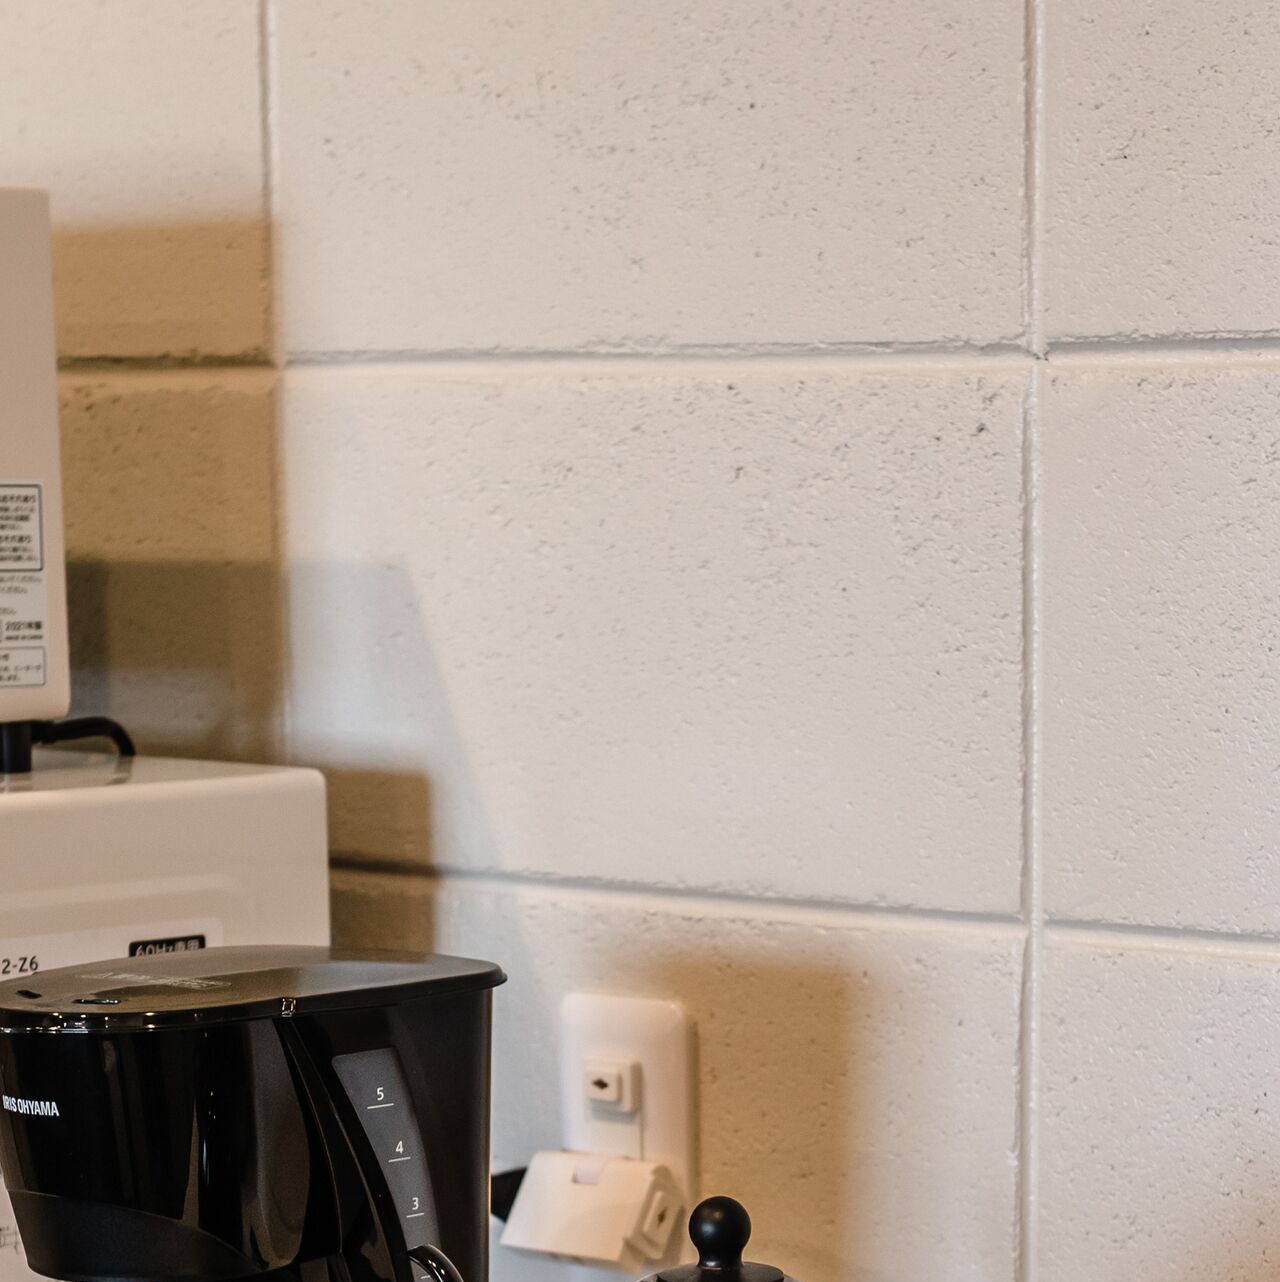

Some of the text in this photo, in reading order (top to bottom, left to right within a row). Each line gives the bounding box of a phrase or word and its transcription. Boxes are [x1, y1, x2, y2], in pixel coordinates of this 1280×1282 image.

[376, 1086, 385, 1101] 5
[2, 1094, 60, 1117] IRIS OHYAMA
[395, 1140, 404, 1153] 4
[411, 1197, 420, 1210] 3
